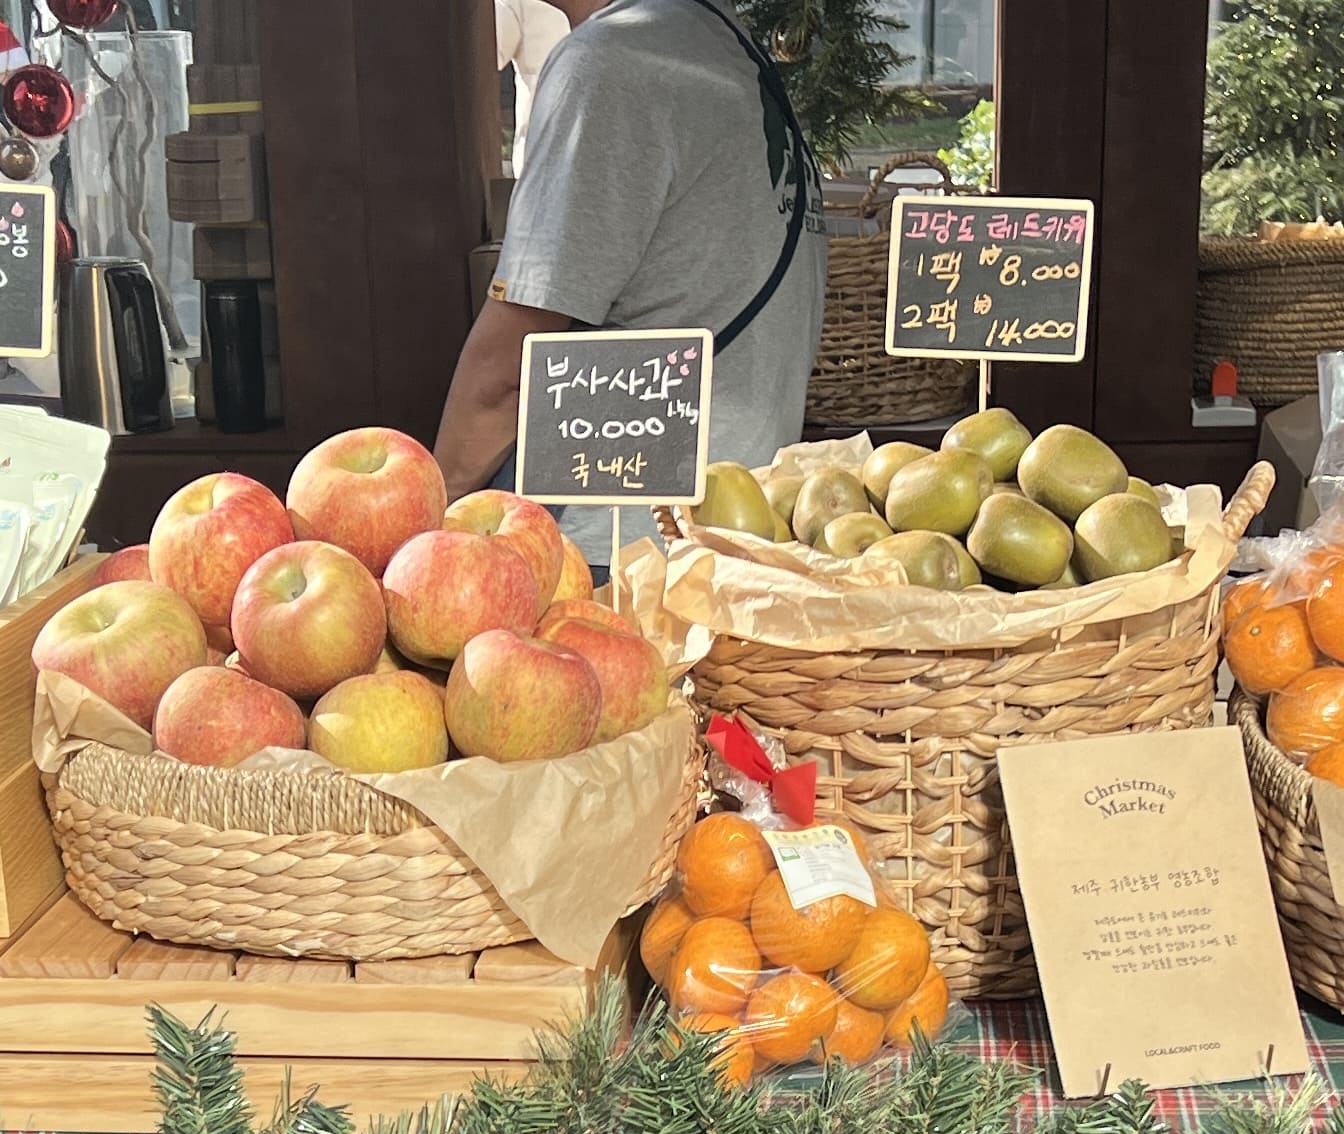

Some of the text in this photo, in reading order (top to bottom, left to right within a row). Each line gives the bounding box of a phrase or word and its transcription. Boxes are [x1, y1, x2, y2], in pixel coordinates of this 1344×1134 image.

[905, 210, 976, 245] 고당도
[546, 356, 683, 409] 부사사과
[571, 452, 647, 488] 국내산
[1084, 778, 1177, 806] Christmas
[1099, 796, 1166, 819] Market
[1071, 866, 1220, 896] 제주 귀한농부 영농조합
